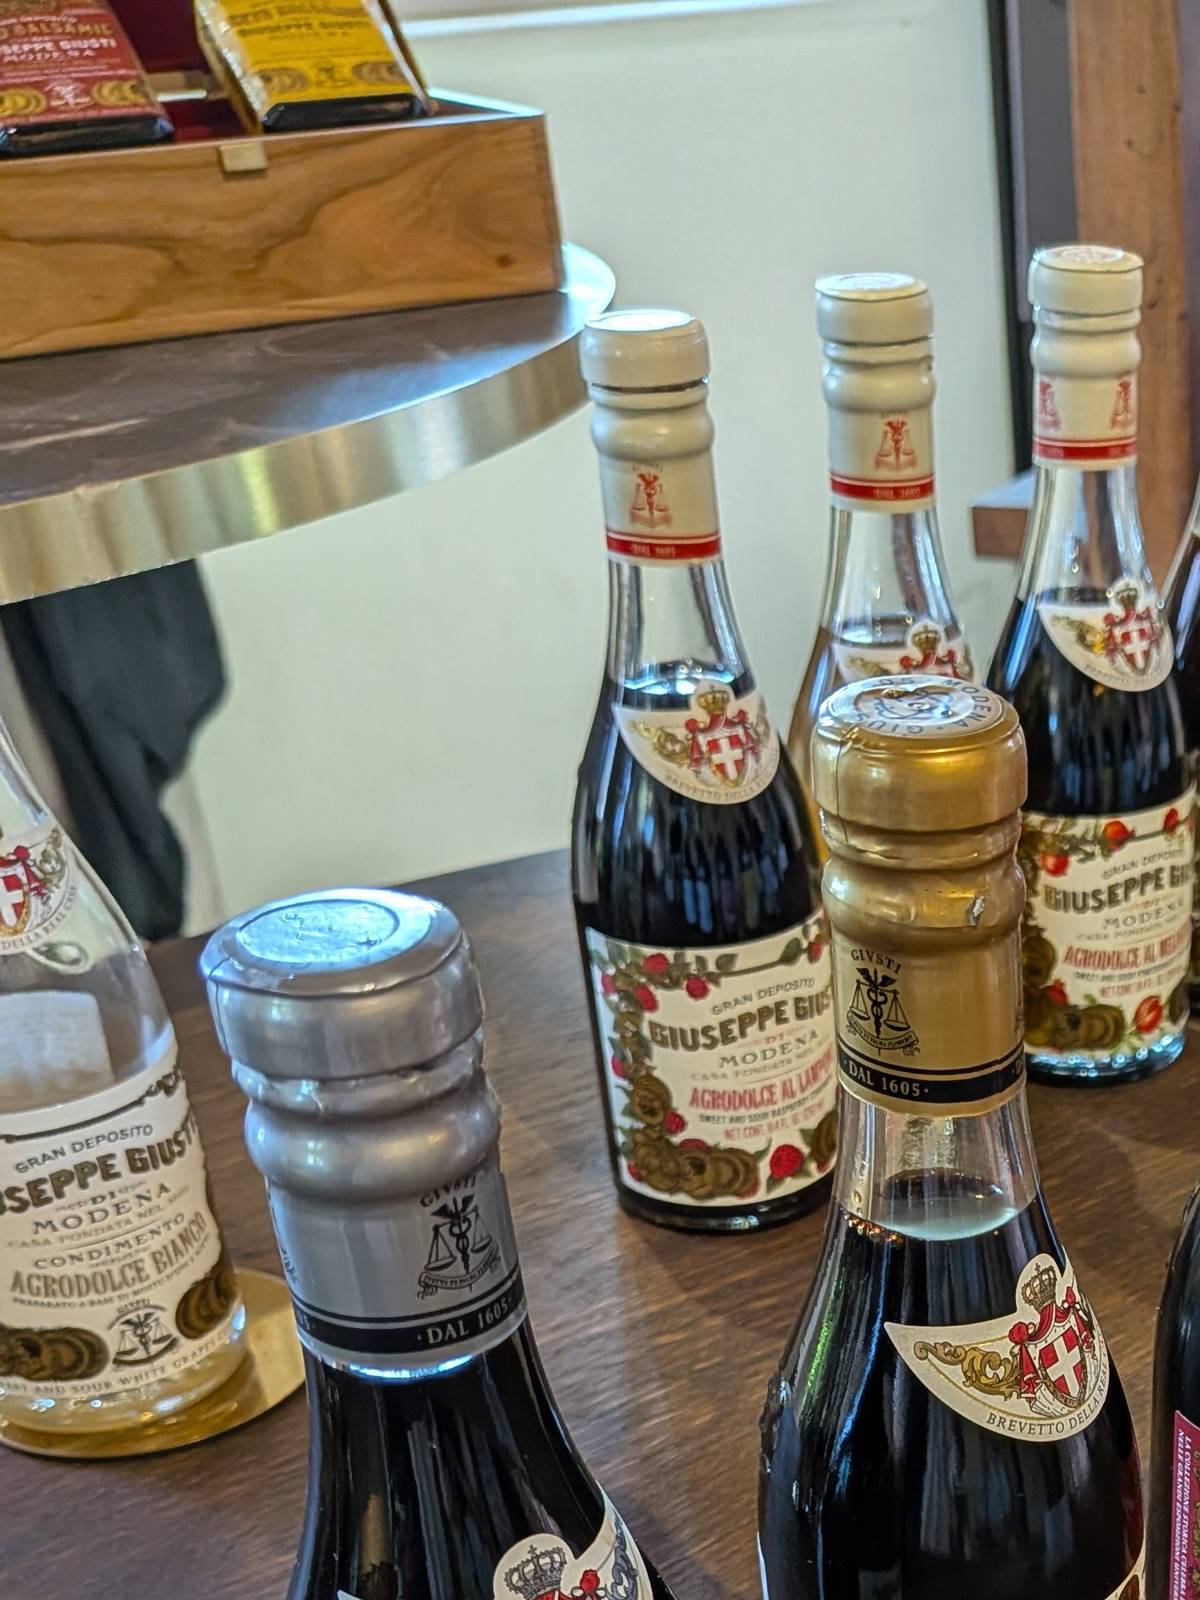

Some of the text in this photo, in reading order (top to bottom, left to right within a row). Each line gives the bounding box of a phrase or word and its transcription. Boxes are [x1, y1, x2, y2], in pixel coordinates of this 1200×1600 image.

[1043, 867, 1165, 914] GIUSEPPE
[850, 948, 902, 976] GIVSTI
[710, 977, 816, 1016] GRAN DEPOSITO
[647, 999, 791, 1052] GIUSEPPE
[718, 1029, 819, 1069] MODENA
[688, 1083, 778, 1111] AGRODOLCE
[781, 1077, 797, 1101] AL
[849, 1059, 921, 1097] DAL 1605
[15, 1123, 154, 1174] GRAN DEPOSITO
[32, 1182, 172, 1235] MODENA
[91, 1190, 119, 1206] DI
[419, 1174, 477, 1208] GIVSTI
[9, 1219, 134, 1248] CASA FONDATA
[33, 1211, 186, 1270] CONDIMENTO
[10, 1210, 208, 1299] AGRODOLCE BIANCO
[426, 1300, 510, 1345] DAL 1605
[71, 1366, 168, 1393] SOUR WHITE
[985, 1398, 1101, 1436] BREVETTO DELLA
